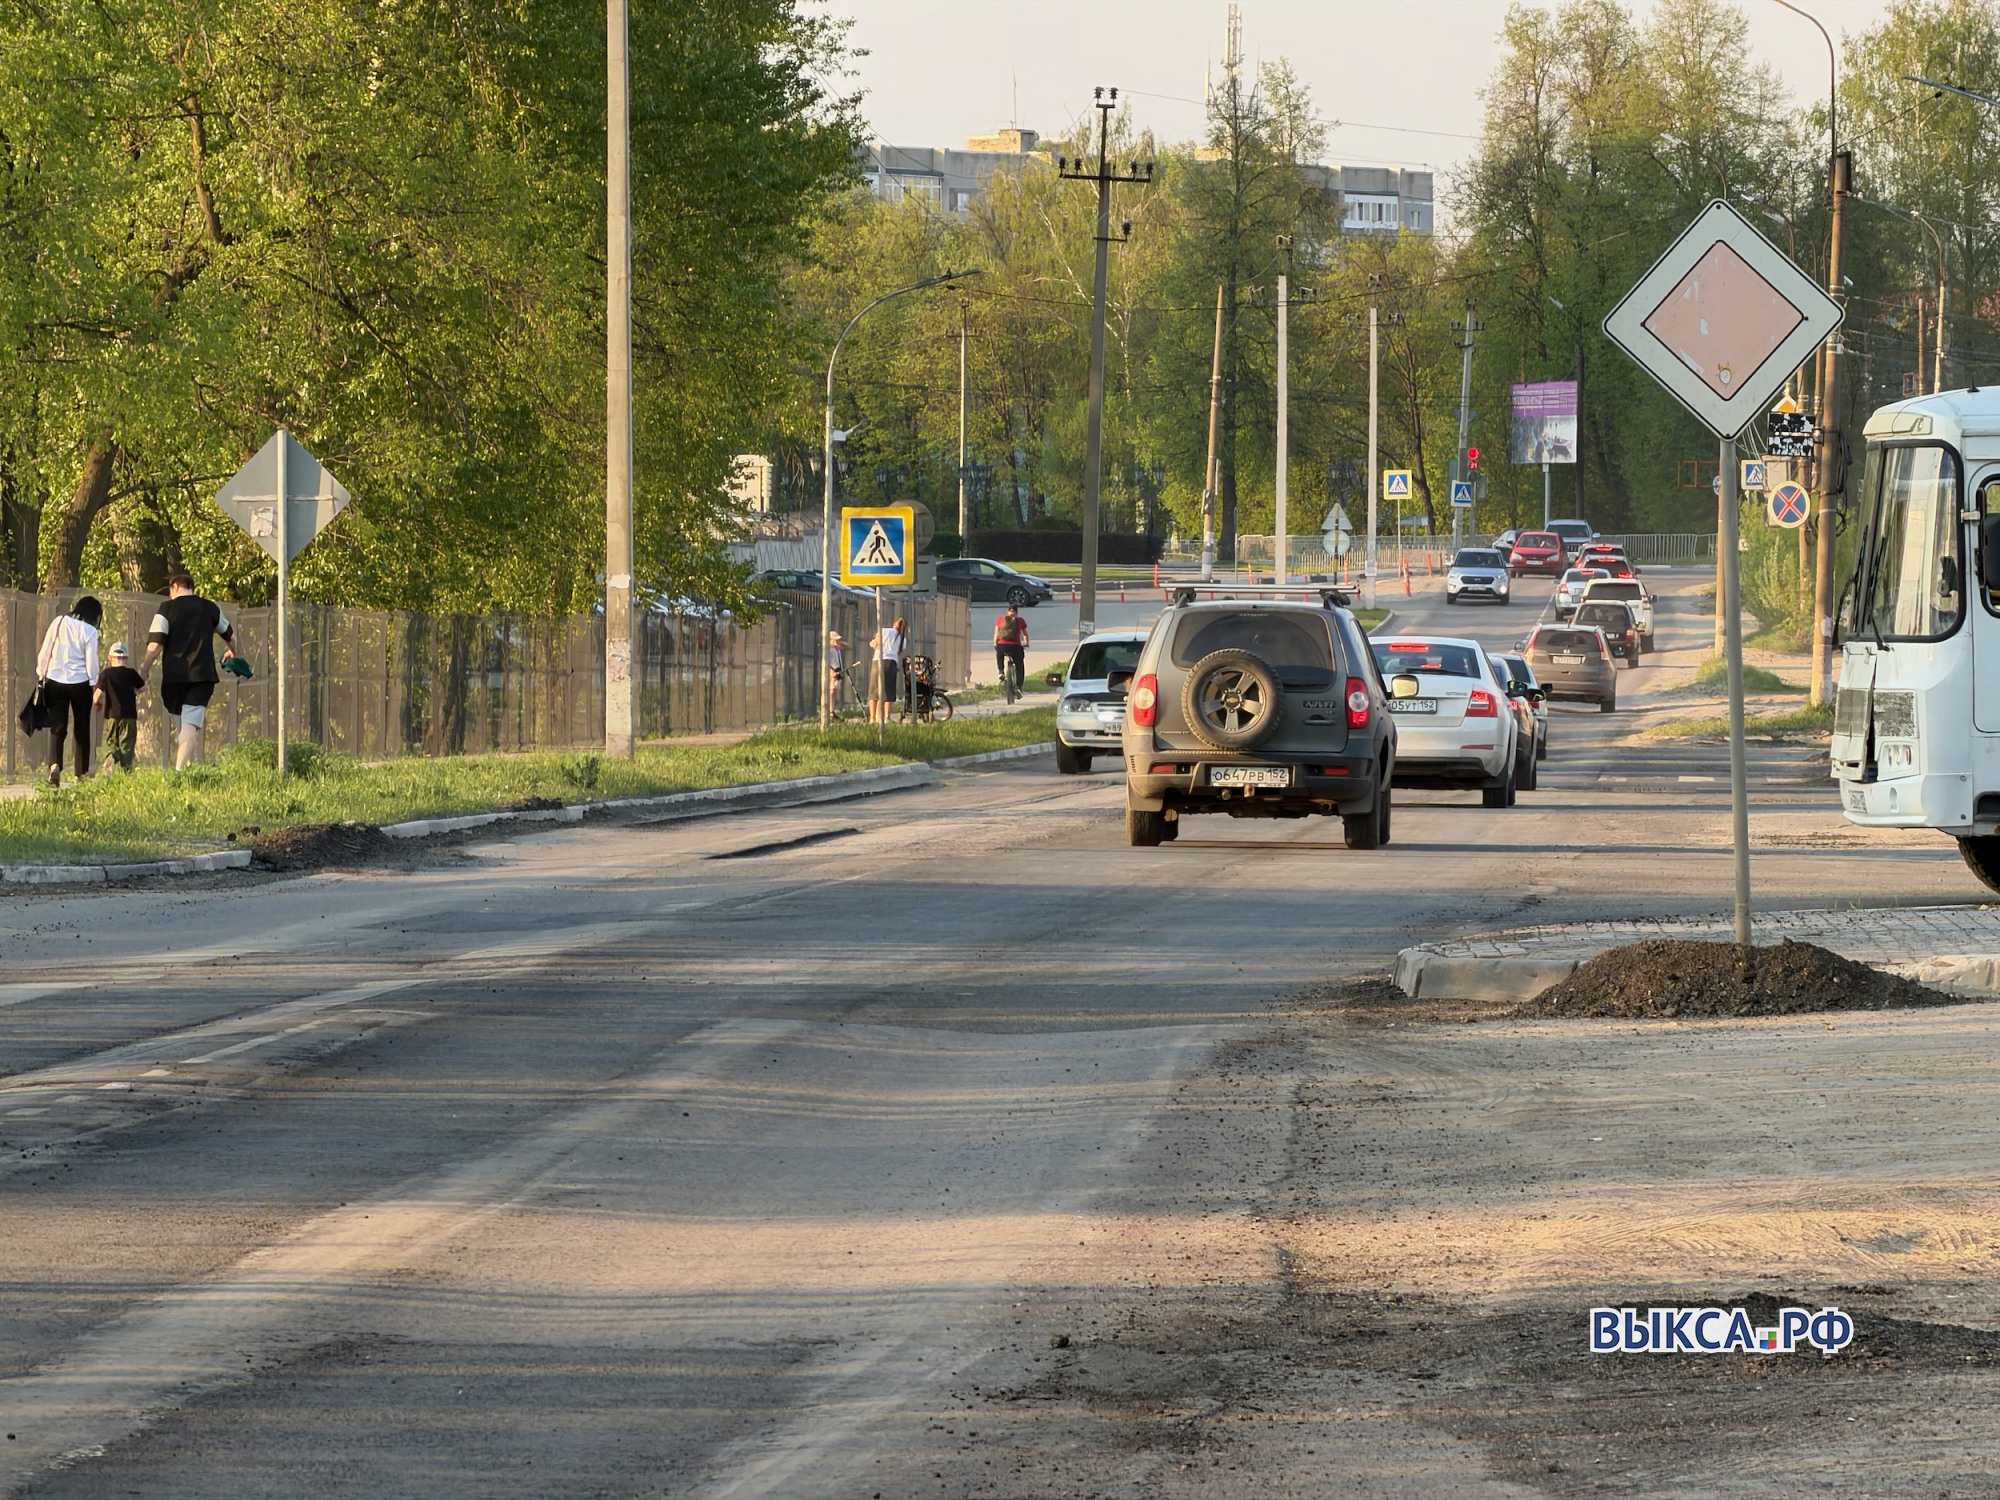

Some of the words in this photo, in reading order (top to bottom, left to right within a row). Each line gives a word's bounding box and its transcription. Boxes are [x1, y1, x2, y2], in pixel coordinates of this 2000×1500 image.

[1419, 701, 1434, 709] 152
[1214, 769, 1264, 781] О647РВ
[1266, 769, 1285, 778] 152
